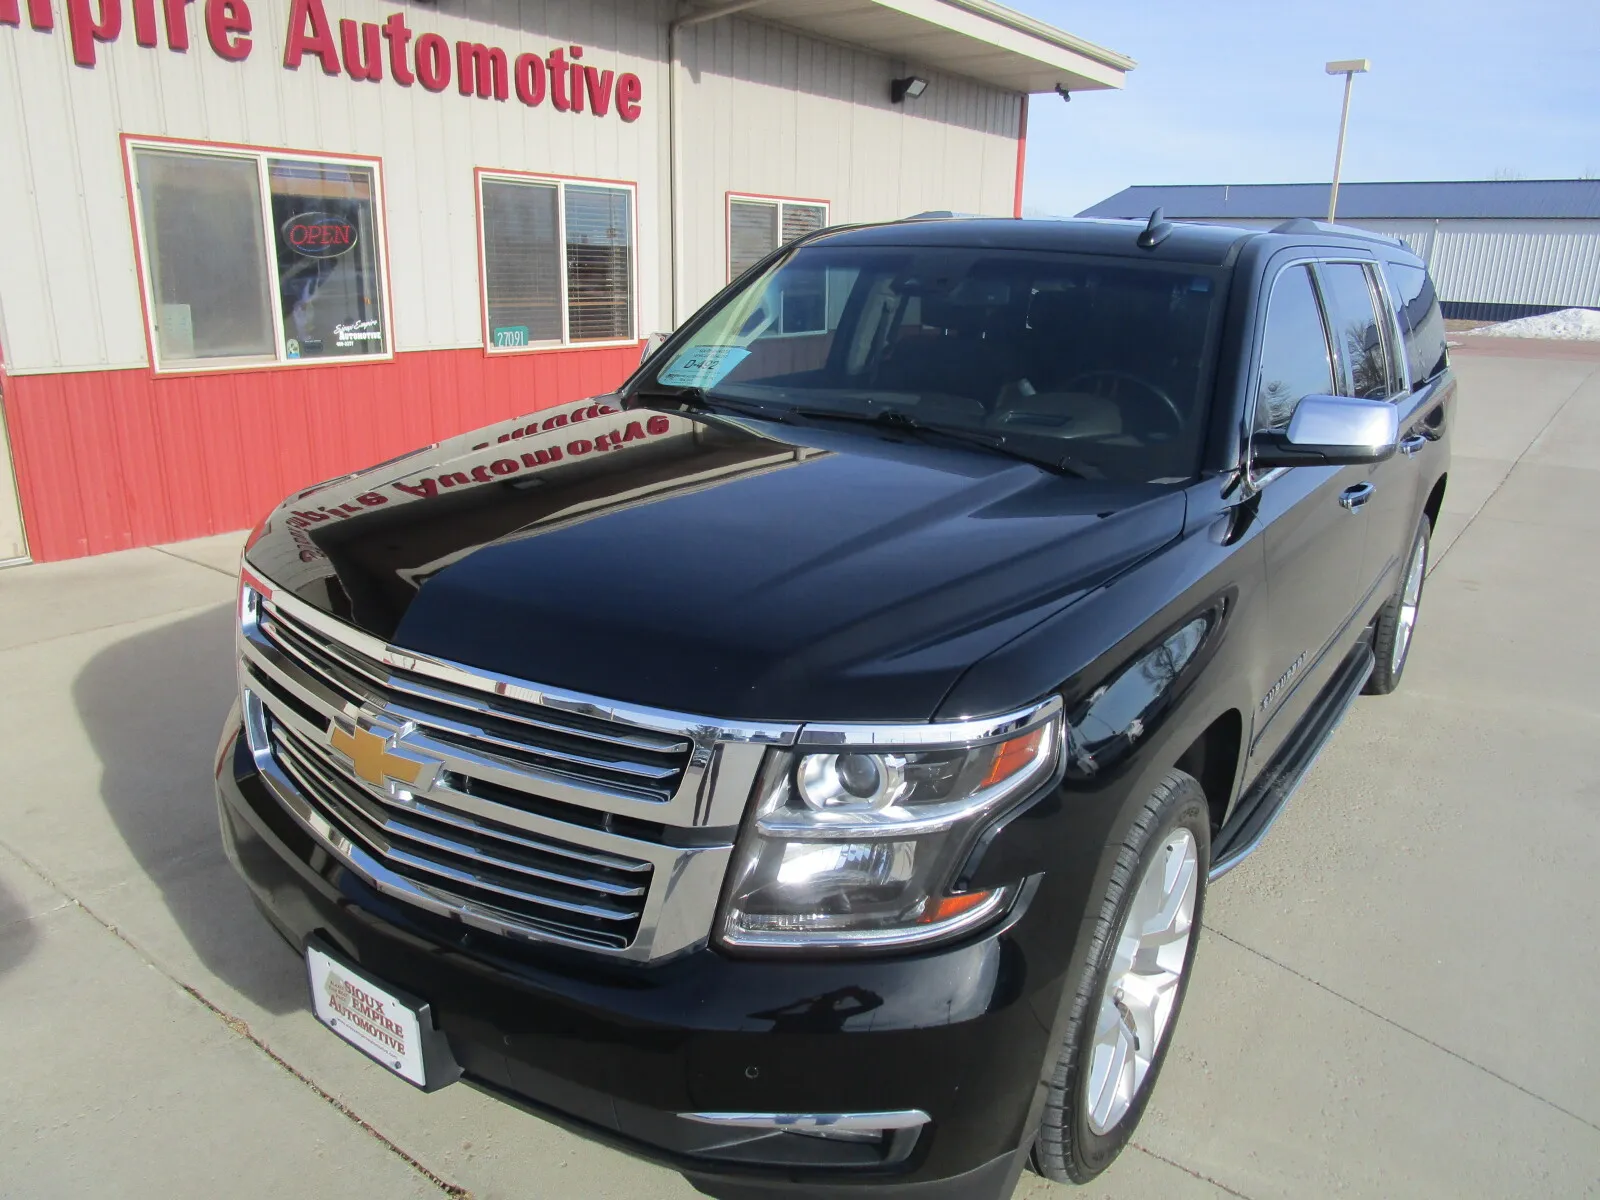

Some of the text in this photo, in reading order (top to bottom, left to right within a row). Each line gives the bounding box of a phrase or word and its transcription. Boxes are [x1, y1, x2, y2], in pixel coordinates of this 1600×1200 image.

[283, 0, 641, 122] Automotive
[290, 224, 350, 245] OPEN
[498, 331, 524, 347] 27091
[344, 980, 385, 1015] SIOUX
[329, 994, 406, 1055] AUTOMOTIVE
[352, 997, 404, 1038] EMPIRE
